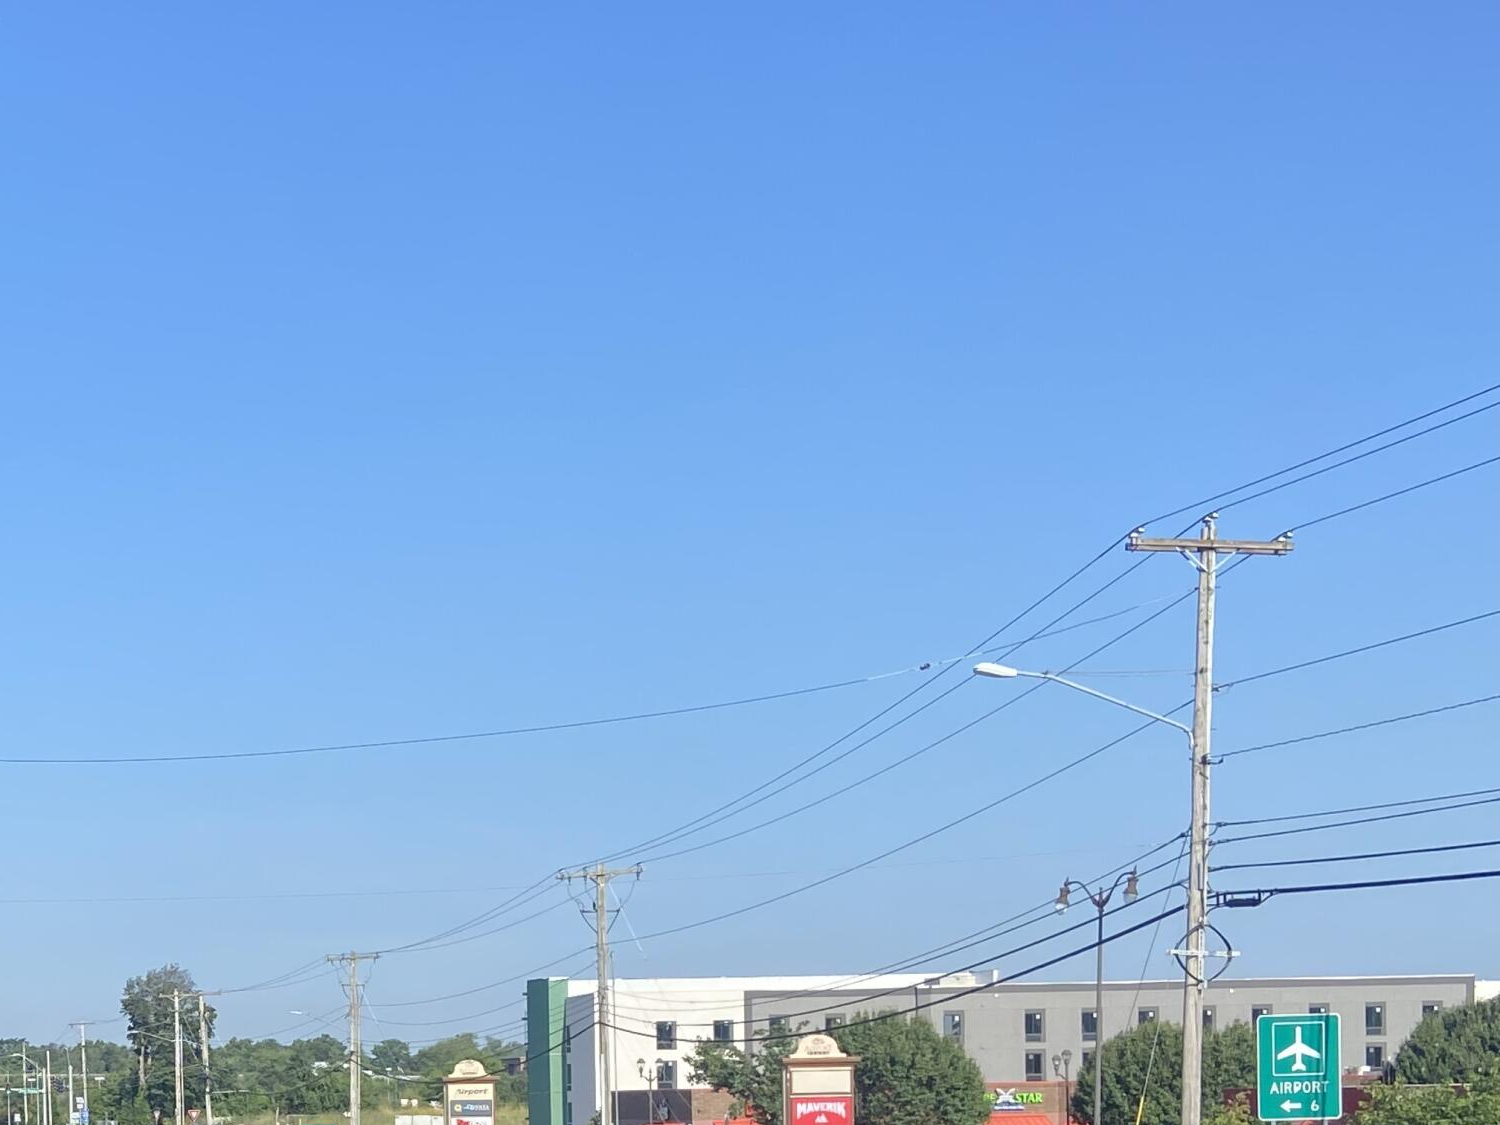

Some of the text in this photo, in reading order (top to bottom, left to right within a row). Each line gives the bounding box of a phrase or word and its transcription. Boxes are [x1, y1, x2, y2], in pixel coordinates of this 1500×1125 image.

[1269, 1080, 1330, 1095] AIRPORT
[1015, 1092, 1043, 1103] STAR
[796, 1101, 847, 1120] MAVERIK
[1310, 1099, 1320, 1111] 6
